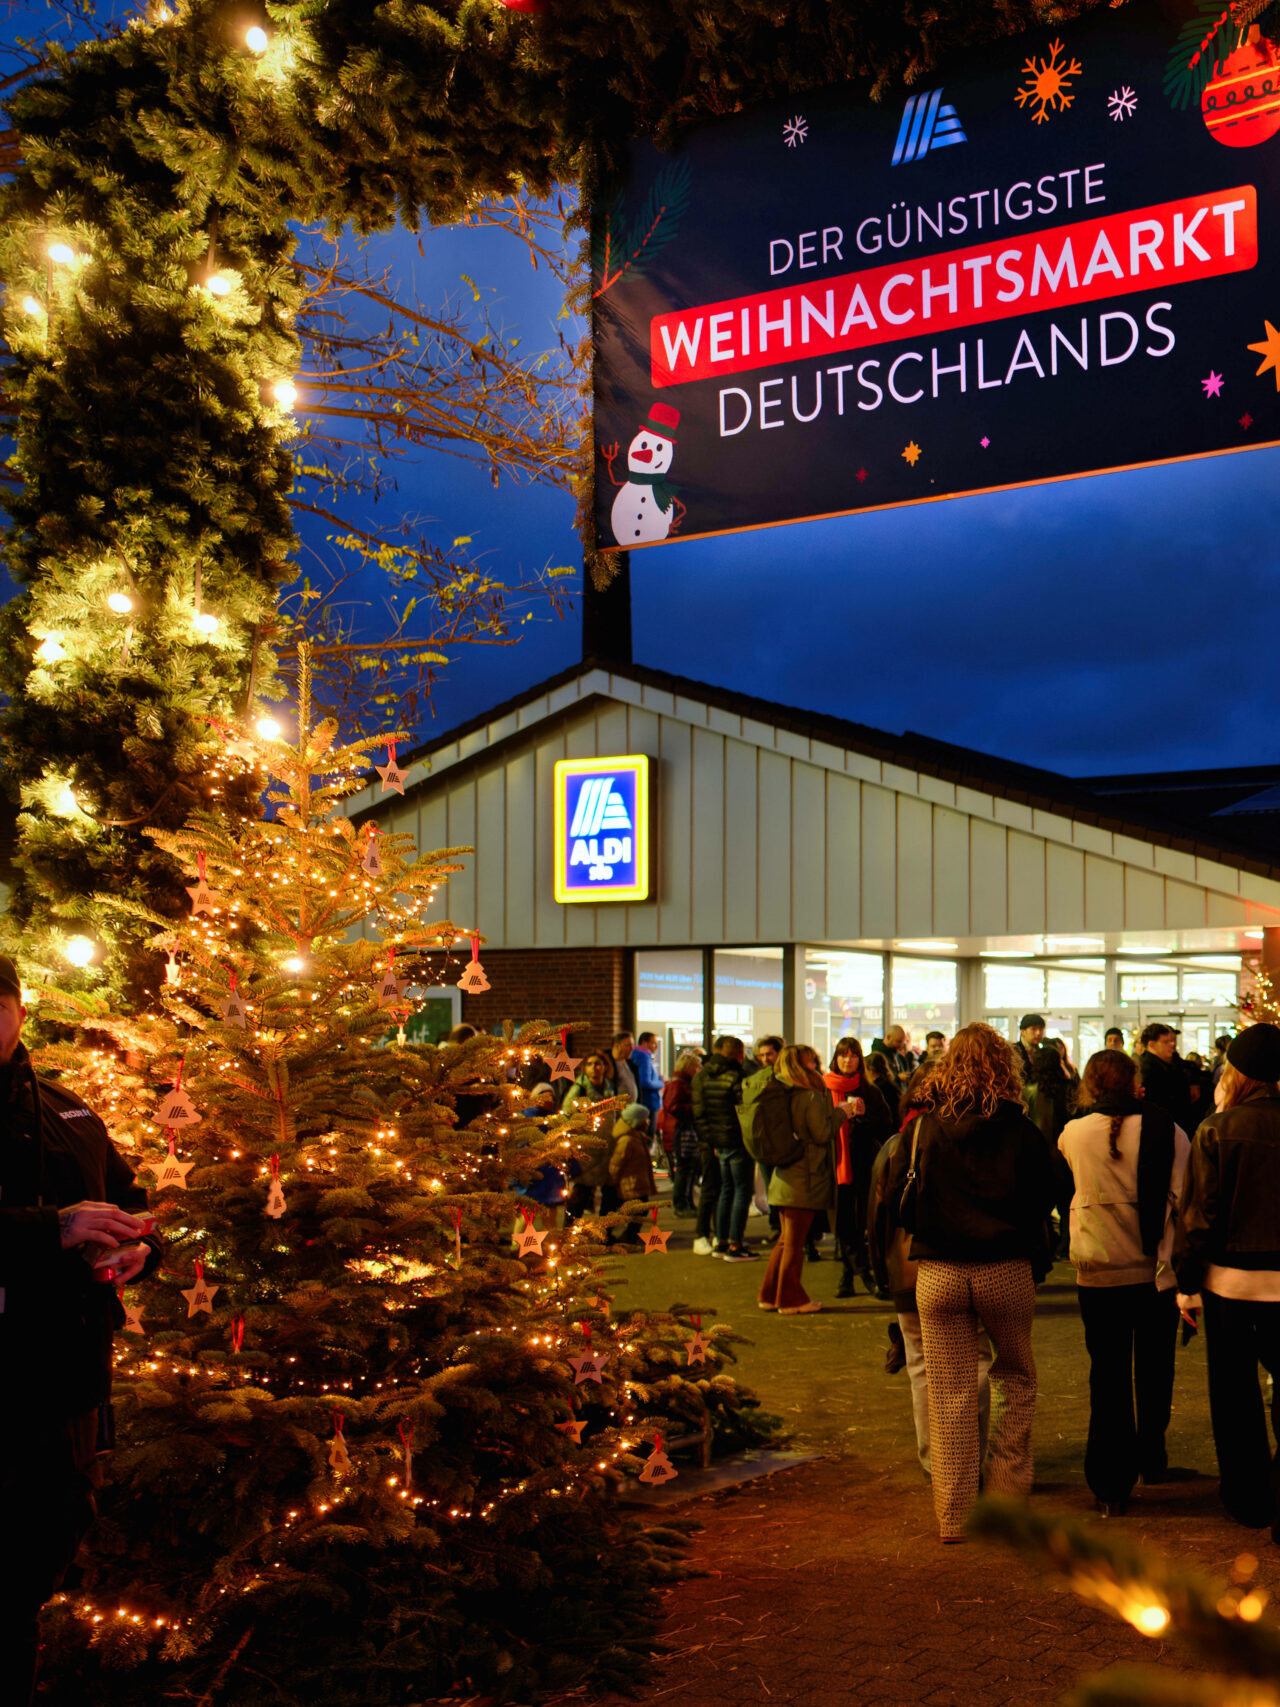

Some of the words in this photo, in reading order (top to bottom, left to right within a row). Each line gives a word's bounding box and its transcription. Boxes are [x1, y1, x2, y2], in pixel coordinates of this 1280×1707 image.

[768, 226, 844, 276] DER
[856, 163, 1106, 254] GÜNSTIGSTE
[659, 199, 1246, 372] WEIHNACHTSMARKT
[718, 302, 1176, 438] DEUTSCHLANDS
[570, 836, 632, 866] ALDI
